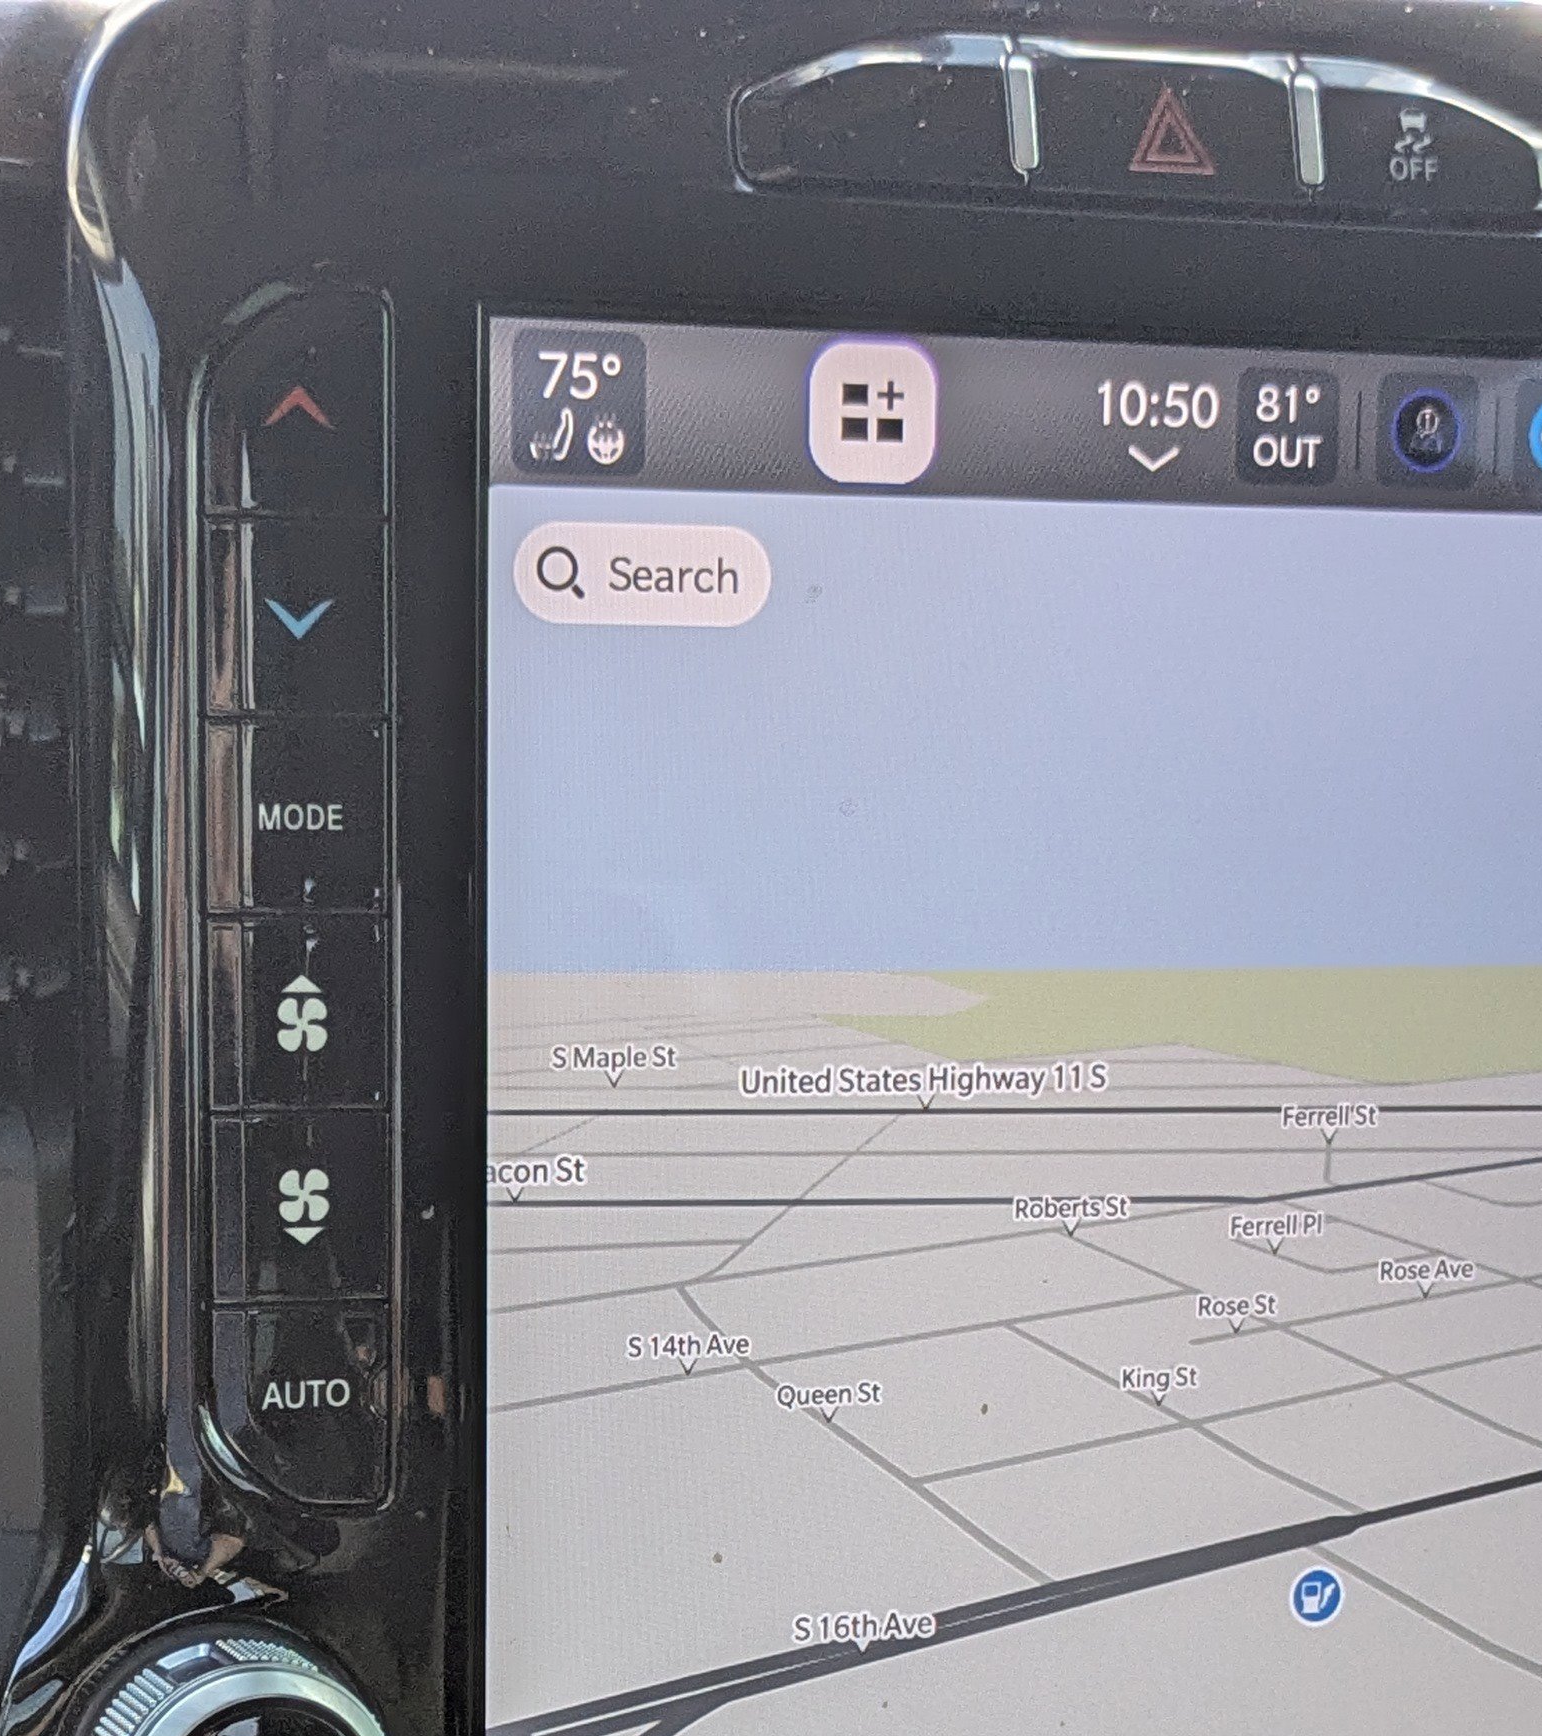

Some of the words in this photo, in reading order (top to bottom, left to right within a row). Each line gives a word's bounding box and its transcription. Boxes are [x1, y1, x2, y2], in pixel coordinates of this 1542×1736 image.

[1389, 156, 1439, 182] OFF
[538, 352, 622, 400] 75°
[1097, 379, 1219, 429] 10:50
[1256, 384, 1320, 423] 81°
[1253, 435, 1323, 470] OUT
[608, 557, 739, 594] Search
[257, 803, 343, 832] MODE
[552, 1046, 567, 1069] S
[572, 1046, 647, 1074] Maple
[653, 1046, 676, 1068] St
[741, 1069, 832, 1096] United
[838, 1069, 921, 1093] States
[929, 1064, 1043, 1098] Highway
[1053, 1066, 1082, 1089] 11
[1090, 1066, 1107, 1089] S
[1283, 1105, 1348, 1126] Ferrell
[1353, 1105, 1376, 1126] St
[557, 1157, 584, 1182] St
[1014, 1198, 1099, 1220] Roberts
[1106, 1197, 1128, 1219] St
[1230, 1215, 1297, 1238] Ferrell
[1303, 1215, 1322, 1236] Pl
[1380, 1260, 1428, 1282] Rose
[1435, 1259, 1474, 1280] Ave
[1198, 1296, 1246, 1319] Rose
[1253, 1295, 1276, 1316] St
[627, 1337, 641, 1358] S
[648, 1335, 700, 1357] 14th
[708, 1335, 749, 1355] Ave
[1122, 1367, 1169, 1392] King
[1175, 1366, 1197, 1387] St
[262, 1379, 351, 1410] AUTO
[777, 1384, 852, 1407] Queen
[857, 1383, 880, 1405] St
[793, 1618, 810, 1641] S
[819, 1614, 877, 1639] 16th
[884, 1614, 933, 1637] Ave
